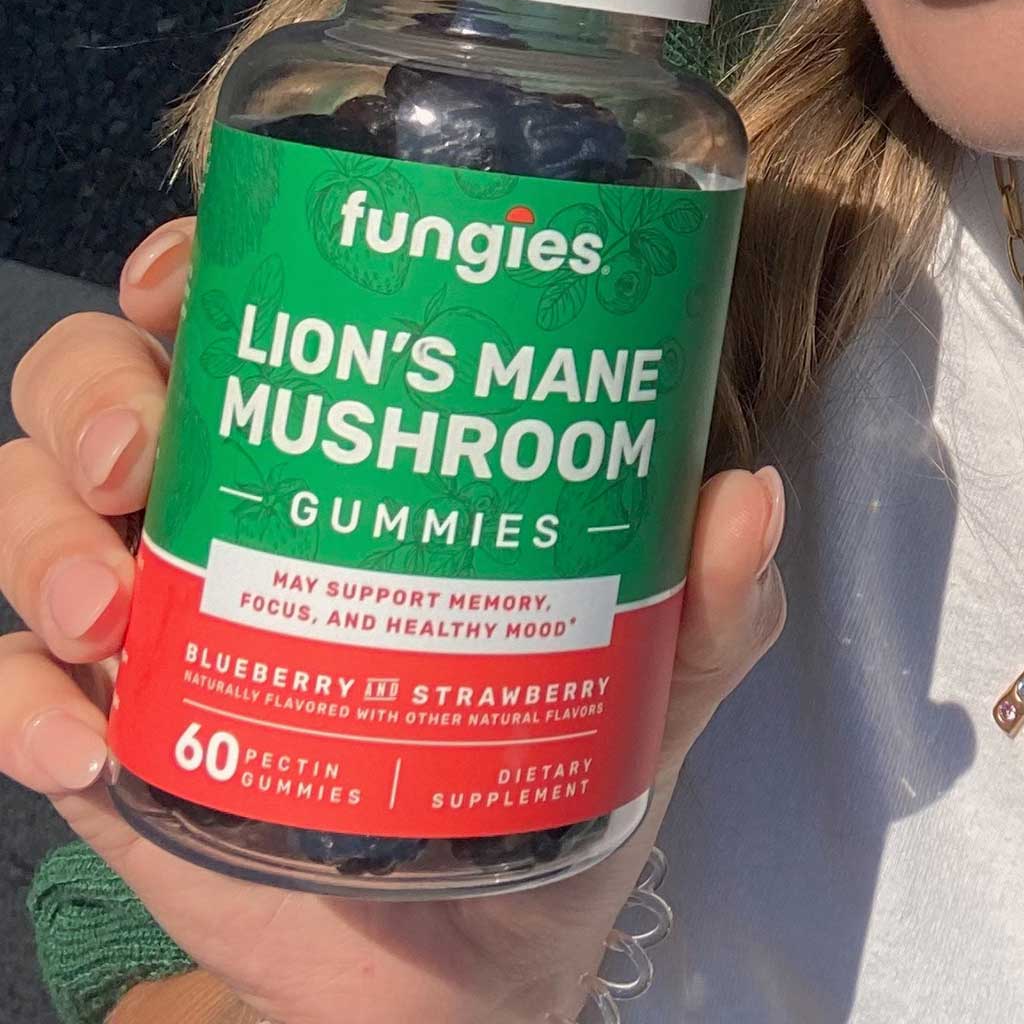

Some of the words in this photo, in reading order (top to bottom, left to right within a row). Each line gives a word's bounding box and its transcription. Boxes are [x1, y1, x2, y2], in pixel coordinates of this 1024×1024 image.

[339, 189, 604, 285] fungies
[237, 304, 455, 393] LION'S
[474, 342, 662, 403] MANE
[218, 377, 656, 482] MUSHROOM
[289, 491, 561, 549] GUMMIES
[240, 592, 318, 625] FOCUS,
[326, 610, 377, 631] AND
[386, 617, 498, 639] HEALTHY
[273, 570, 318, 594] MAY
[326, 581, 440, 609] SUPPORT
[449, 594, 551, 612] MEMORY,
[184, 642, 356, 699] BLUEBERRY
[363, 679, 400, 700] AND
[412, 676, 610, 707] STRAWBERRY
[184, 669, 261, 702] NATURALLY
[264, 692, 350, 719] FLAVORED
[357, 708, 399, 724] WITH
[405, 711, 462, 725] OTHER
[468, 709, 540, 726] NATURAL
[545, 702, 603, 723] FLAVORS
[175, 722, 240, 782] 60
[244, 748, 341, 780] PECTIN
[498, 758, 592, 785] DIETARY
[241, 771, 361, 805] GUMMIES
[432, 779, 590, 809] SUPPLEMENT
